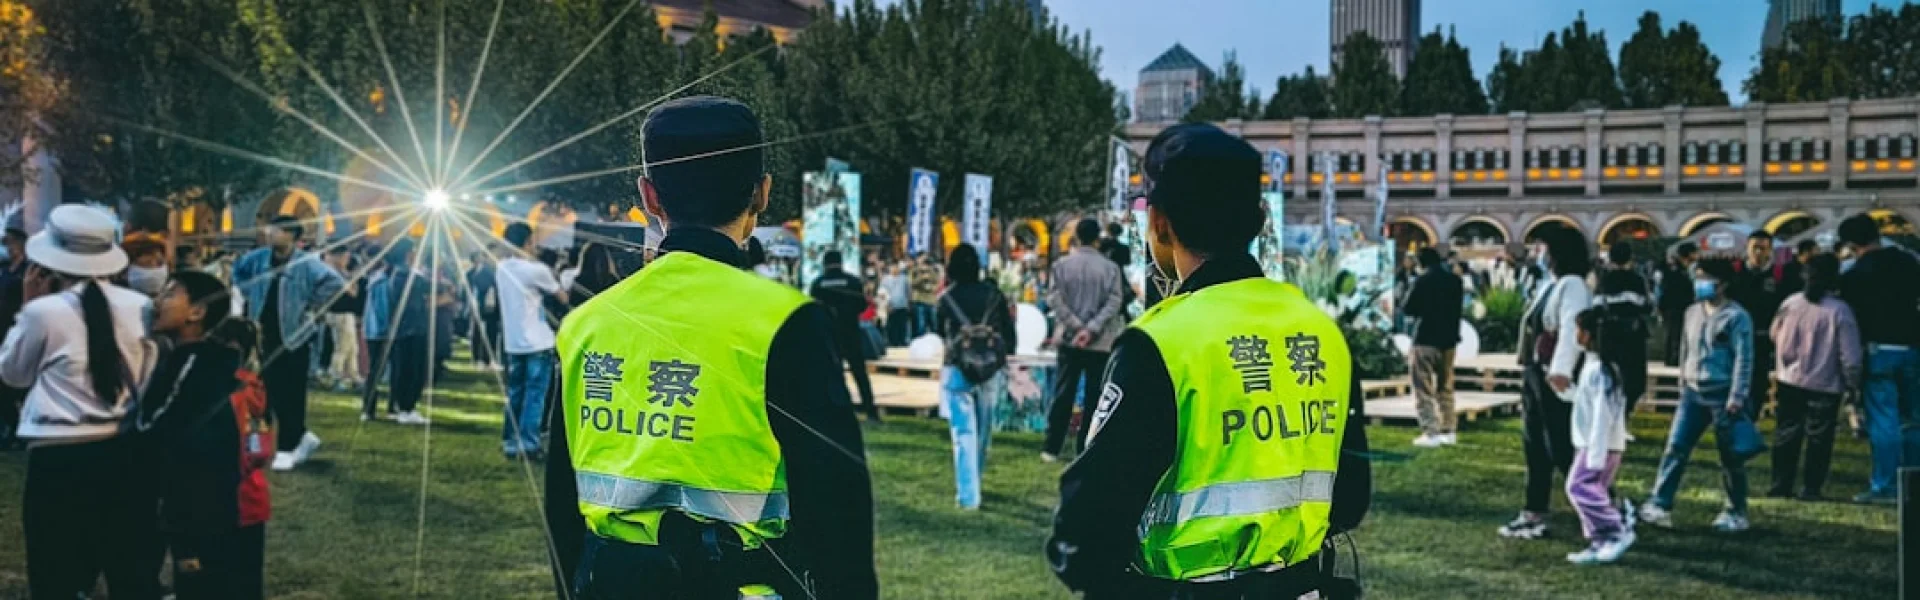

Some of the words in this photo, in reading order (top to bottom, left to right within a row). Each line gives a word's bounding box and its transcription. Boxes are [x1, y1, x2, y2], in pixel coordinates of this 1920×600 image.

[583, 350, 701, 408] 警察
[1226, 332, 1327, 394] 警察
[581, 405, 696, 442] POLICE
[1222, 400, 1338, 446] POLICE
